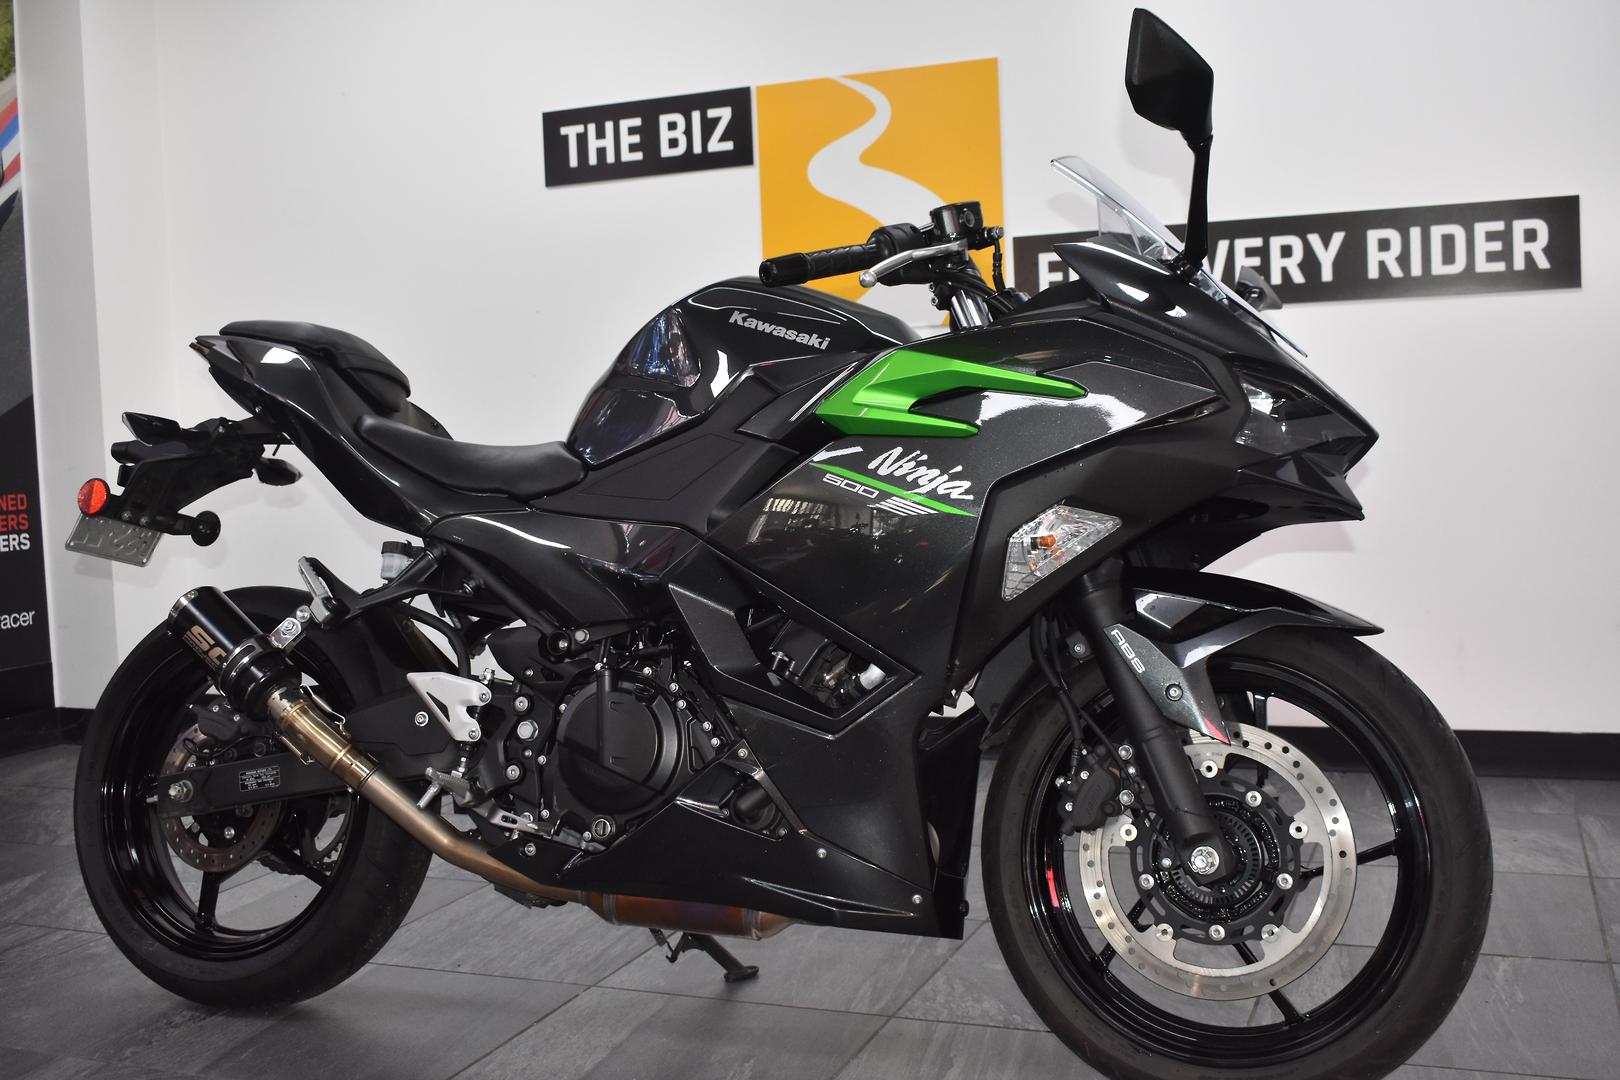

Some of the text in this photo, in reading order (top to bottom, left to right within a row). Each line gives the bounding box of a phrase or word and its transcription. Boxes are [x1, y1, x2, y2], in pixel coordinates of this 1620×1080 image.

[560, 106, 735, 168] THE BIZ
[1202, 218, 1551, 287] VERY RIDER
[728, 310, 831, 350] Kawasaki
[822, 473, 880, 499] 500
[867, 446, 974, 500] Ninja
[0, 533, 31, 552] ERS
[0, 611, 35, 629] acer
[1111, 629, 1145, 673] ABS
